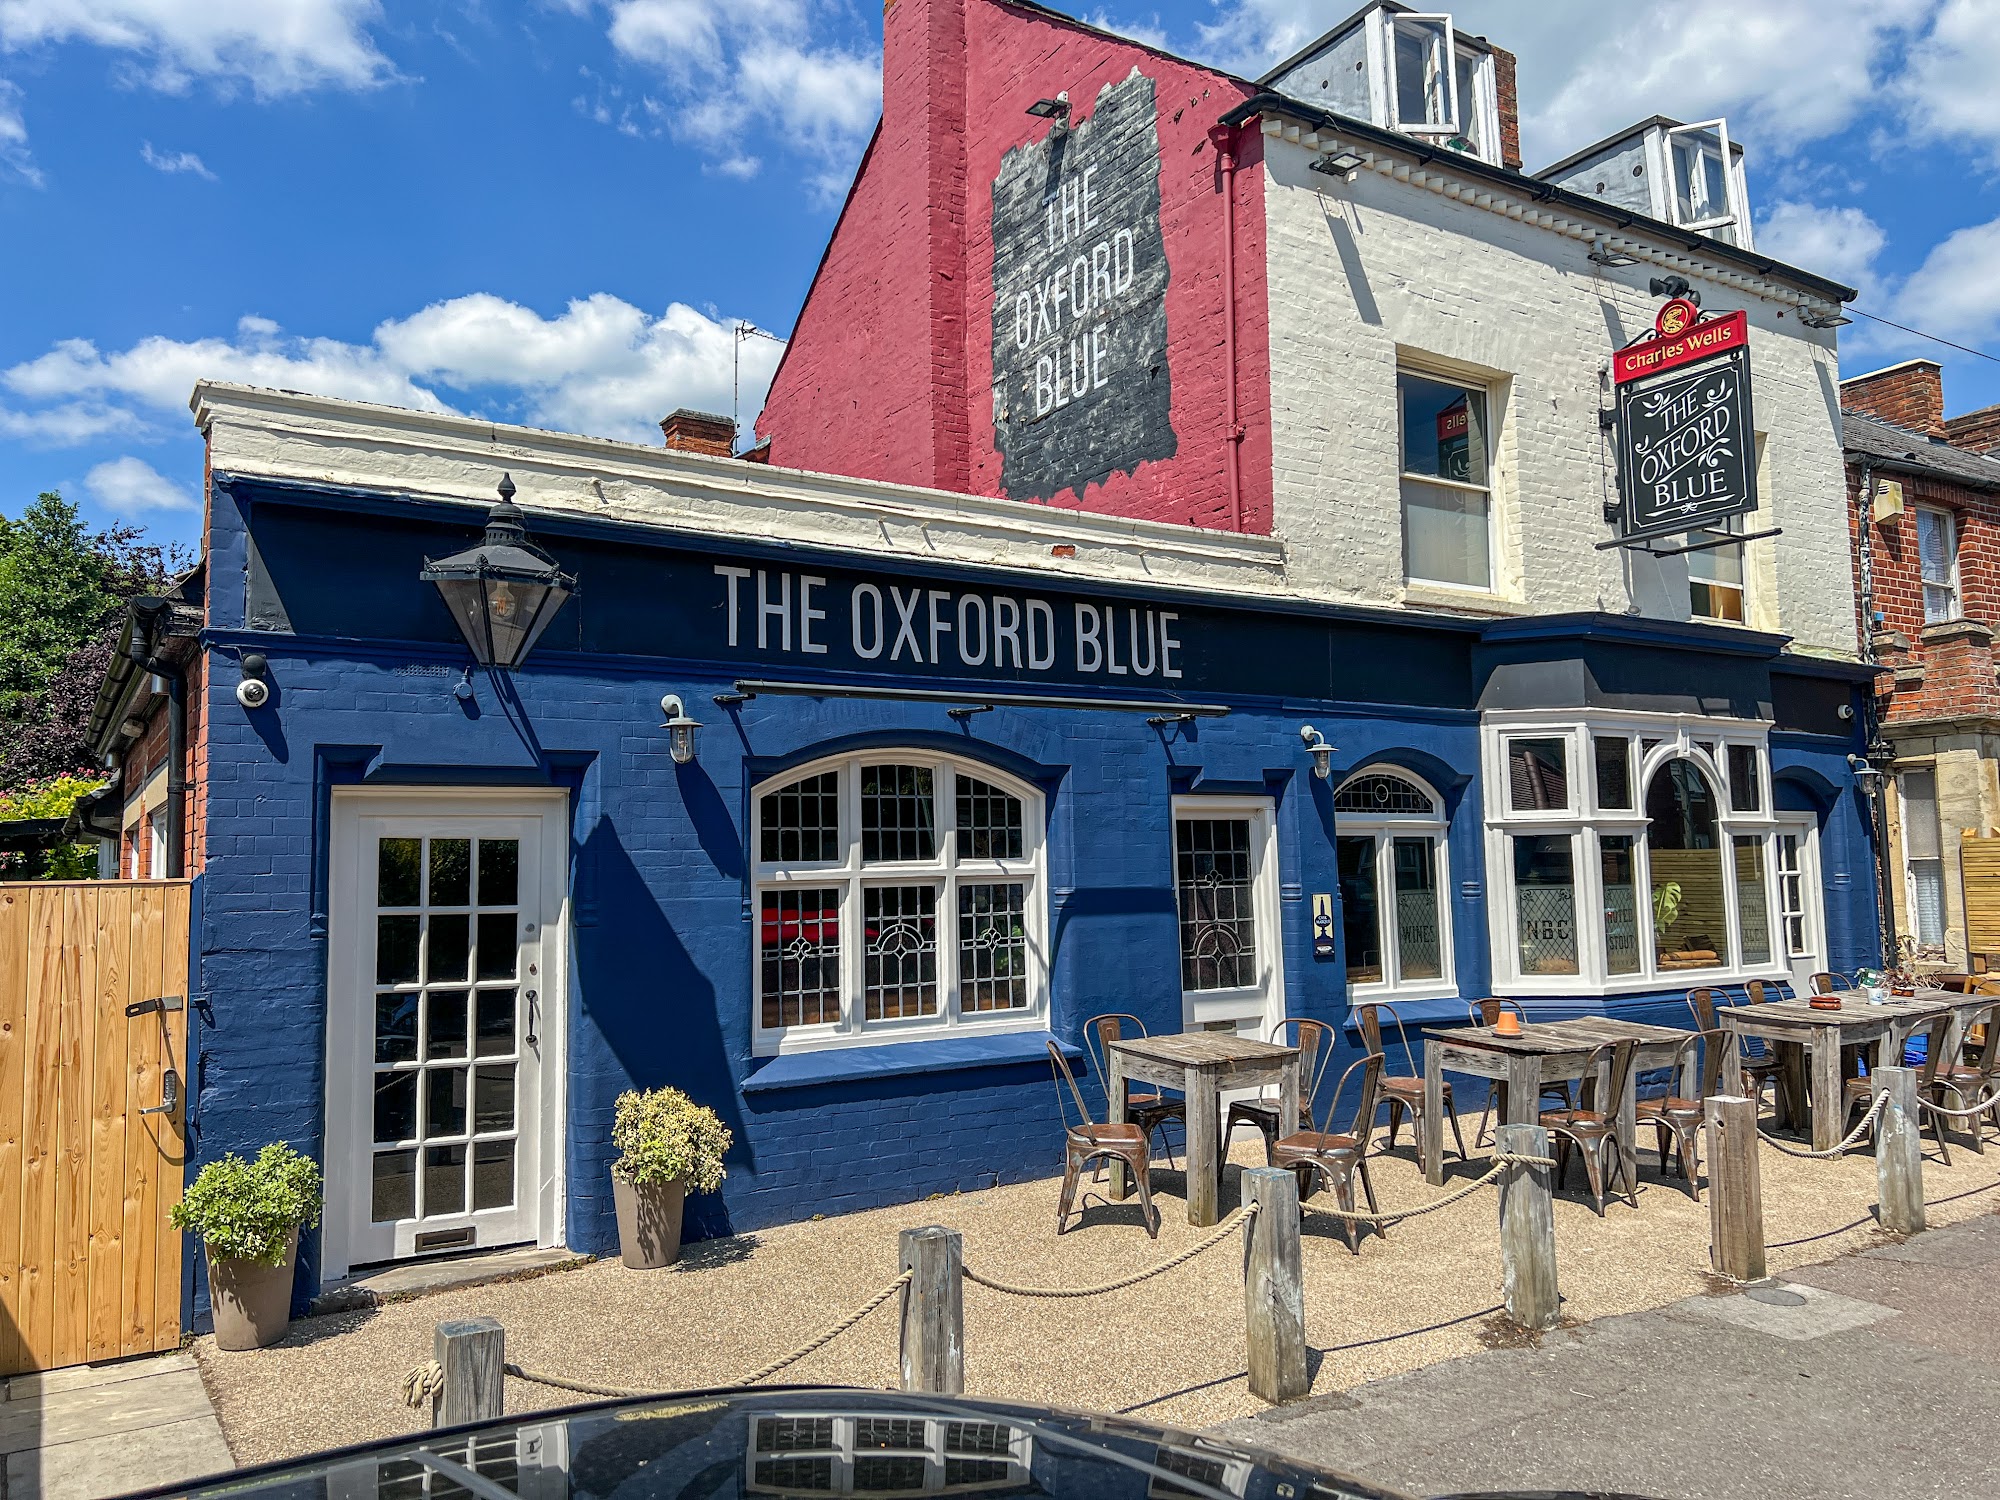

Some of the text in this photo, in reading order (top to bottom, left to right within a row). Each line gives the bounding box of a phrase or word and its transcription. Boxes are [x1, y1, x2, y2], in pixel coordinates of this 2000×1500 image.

[1041, 162, 1100, 253] THE
[1014, 227, 1134, 351] OXFORD
[1035, 322, 1109, 418] BLUE
[1624, 327, 1732, 372] Charles Wells
[1660, 388, 1699, 432] THE
[1640, 406, 1731, 485] OXFORD
[1653, 468, 1728, 508] BLUE
[713, 564, 1183, 679] THE OXFORD BLUE
[1402, 925, 1436, 943] WINES
[1526, 919, 1569, 940] NBC
[1609, 934, 1635, 951] STOUT
